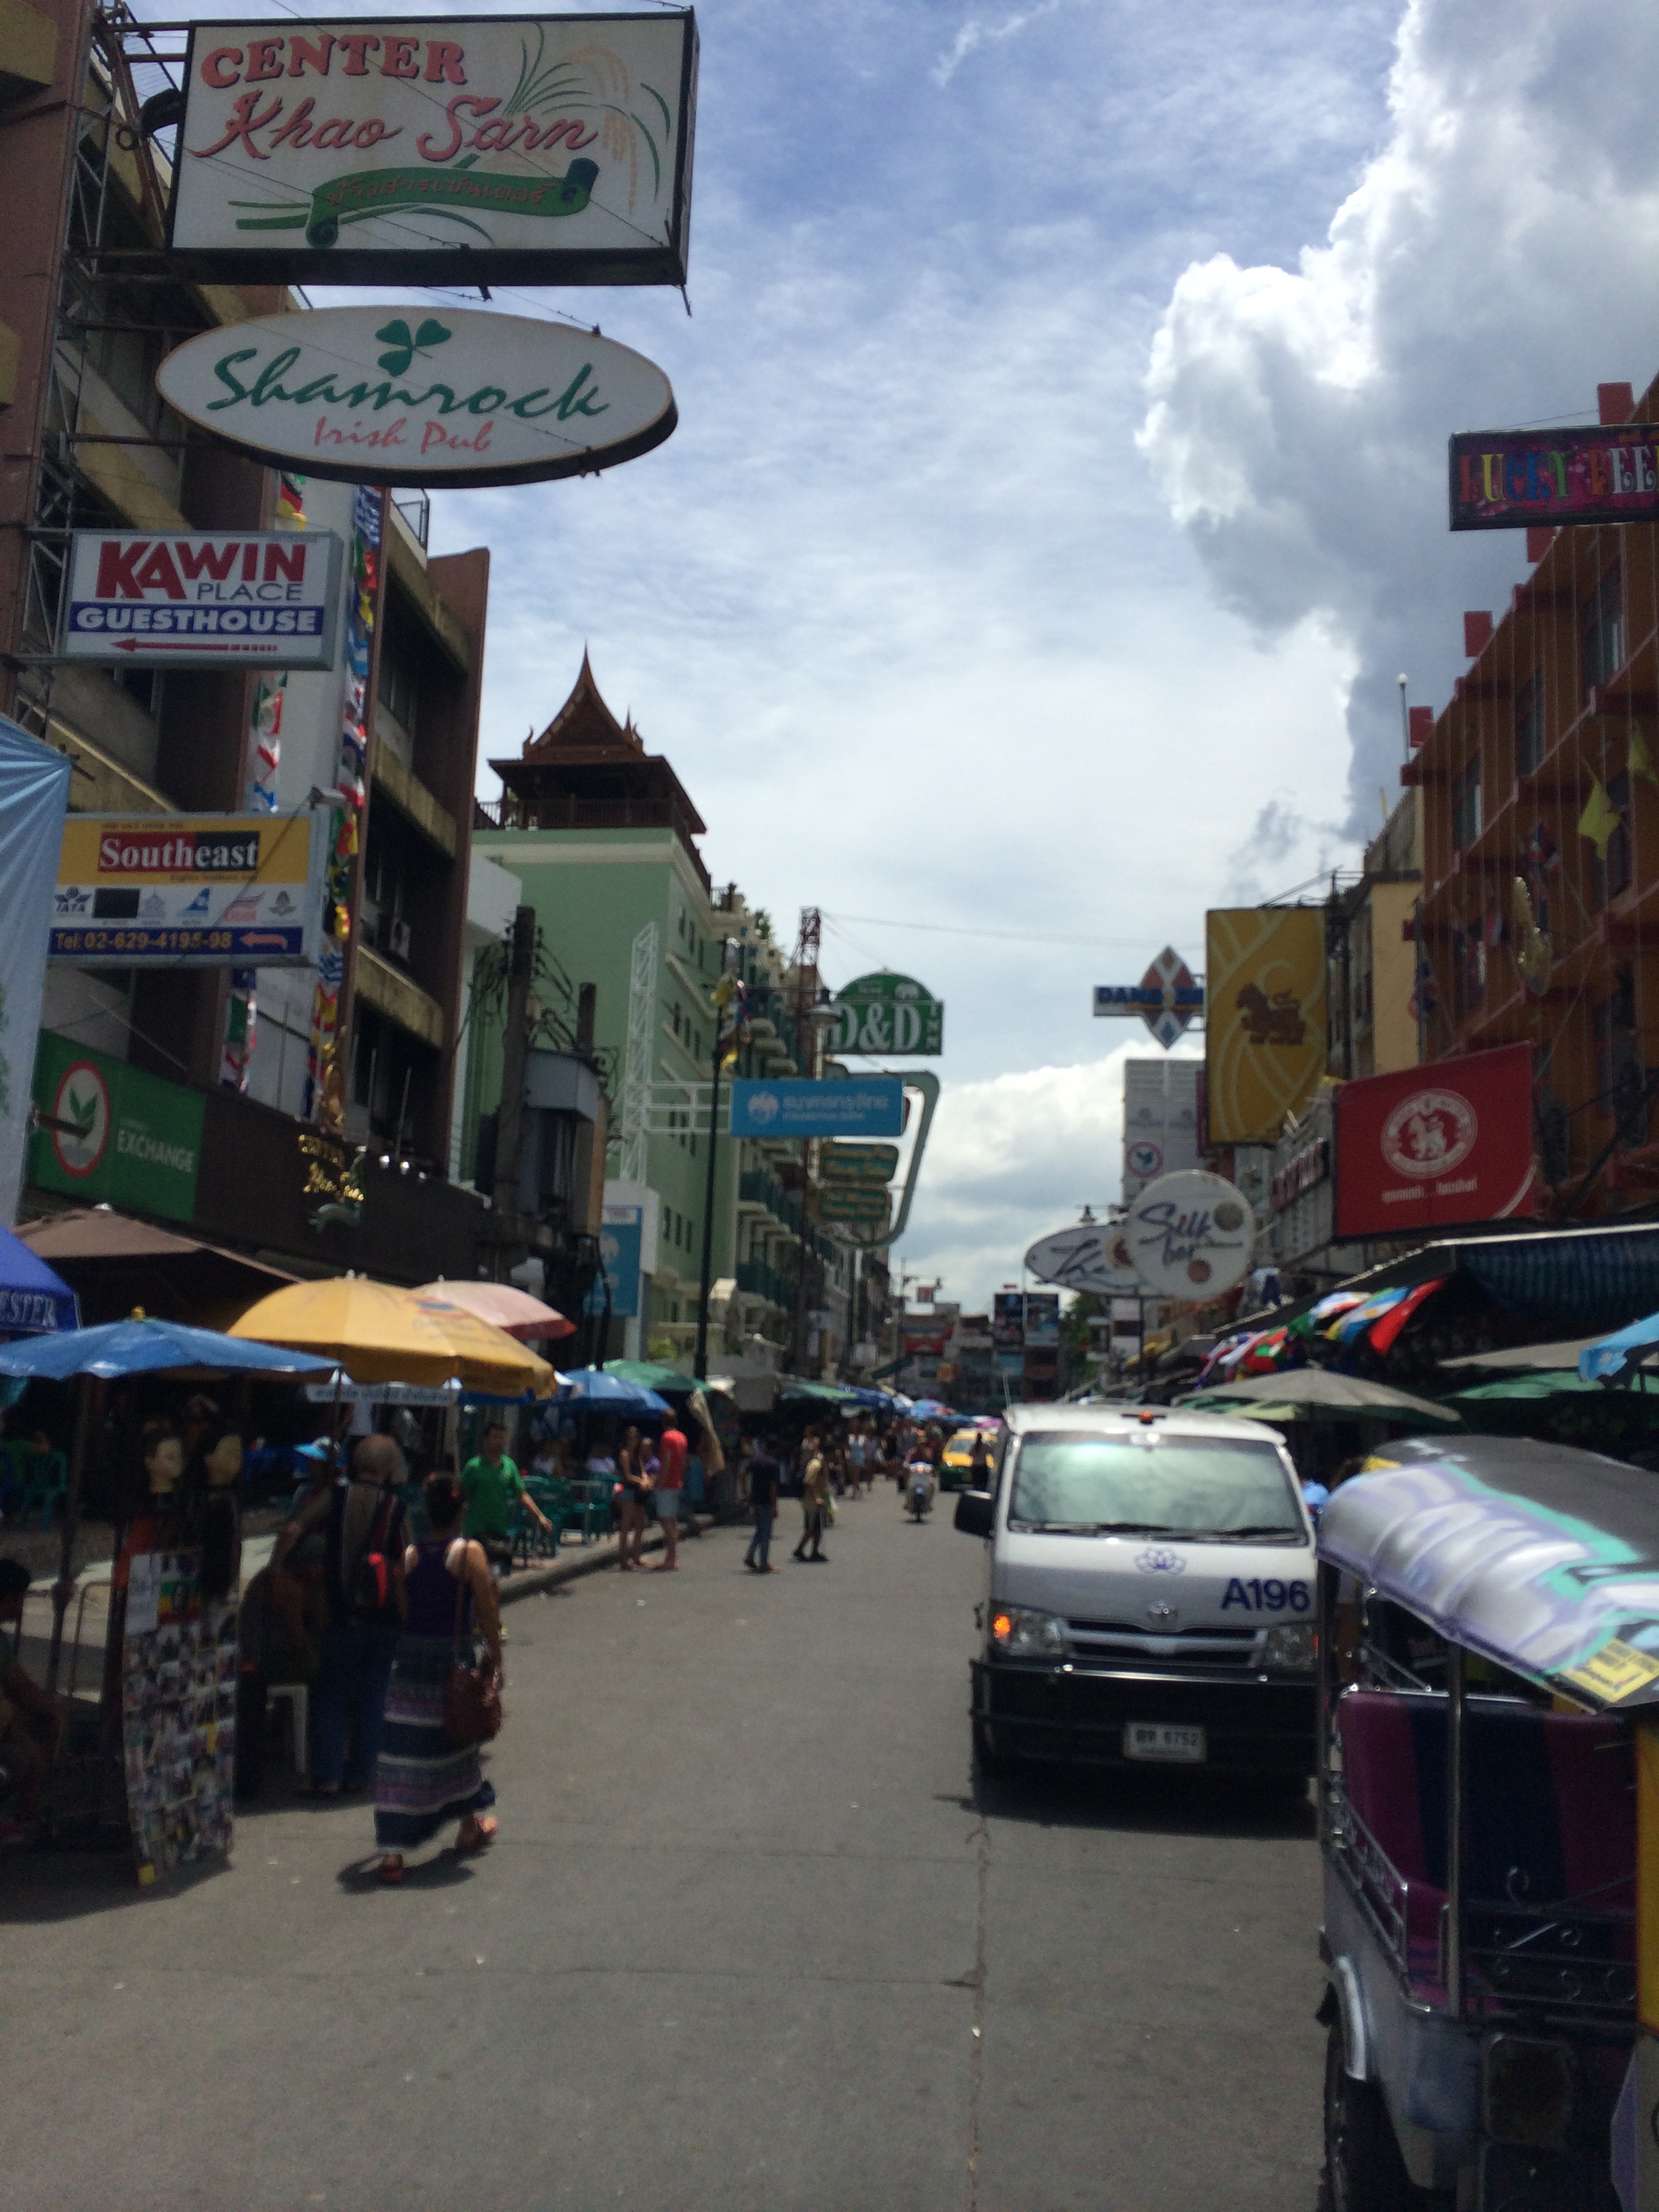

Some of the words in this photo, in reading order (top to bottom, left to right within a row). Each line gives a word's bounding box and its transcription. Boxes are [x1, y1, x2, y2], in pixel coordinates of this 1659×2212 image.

[201, 35, 468, 89] CENTER
[190, 89, 405, 160] Khao
[416, 94, 599, 162] Sarn
[206, 346, 611, 421] Shamrock
[314, 415, 407, 448] Irish
[421, 419, 495, 455] Pub
[1588, 445, 1659, 495] BEE
[95, 541, 307, 600] KAWIN
[197, 582, 304, 602] PLACE
[76, 607, 317, 632] GUESTHOUSE
[99, 838, 260, 868] Southeast
[828, 1001, 922, 1051] D&D
[1138, 1200, 1214, 1246] Silk
[1221, 1578, 1311, 1612] A196
